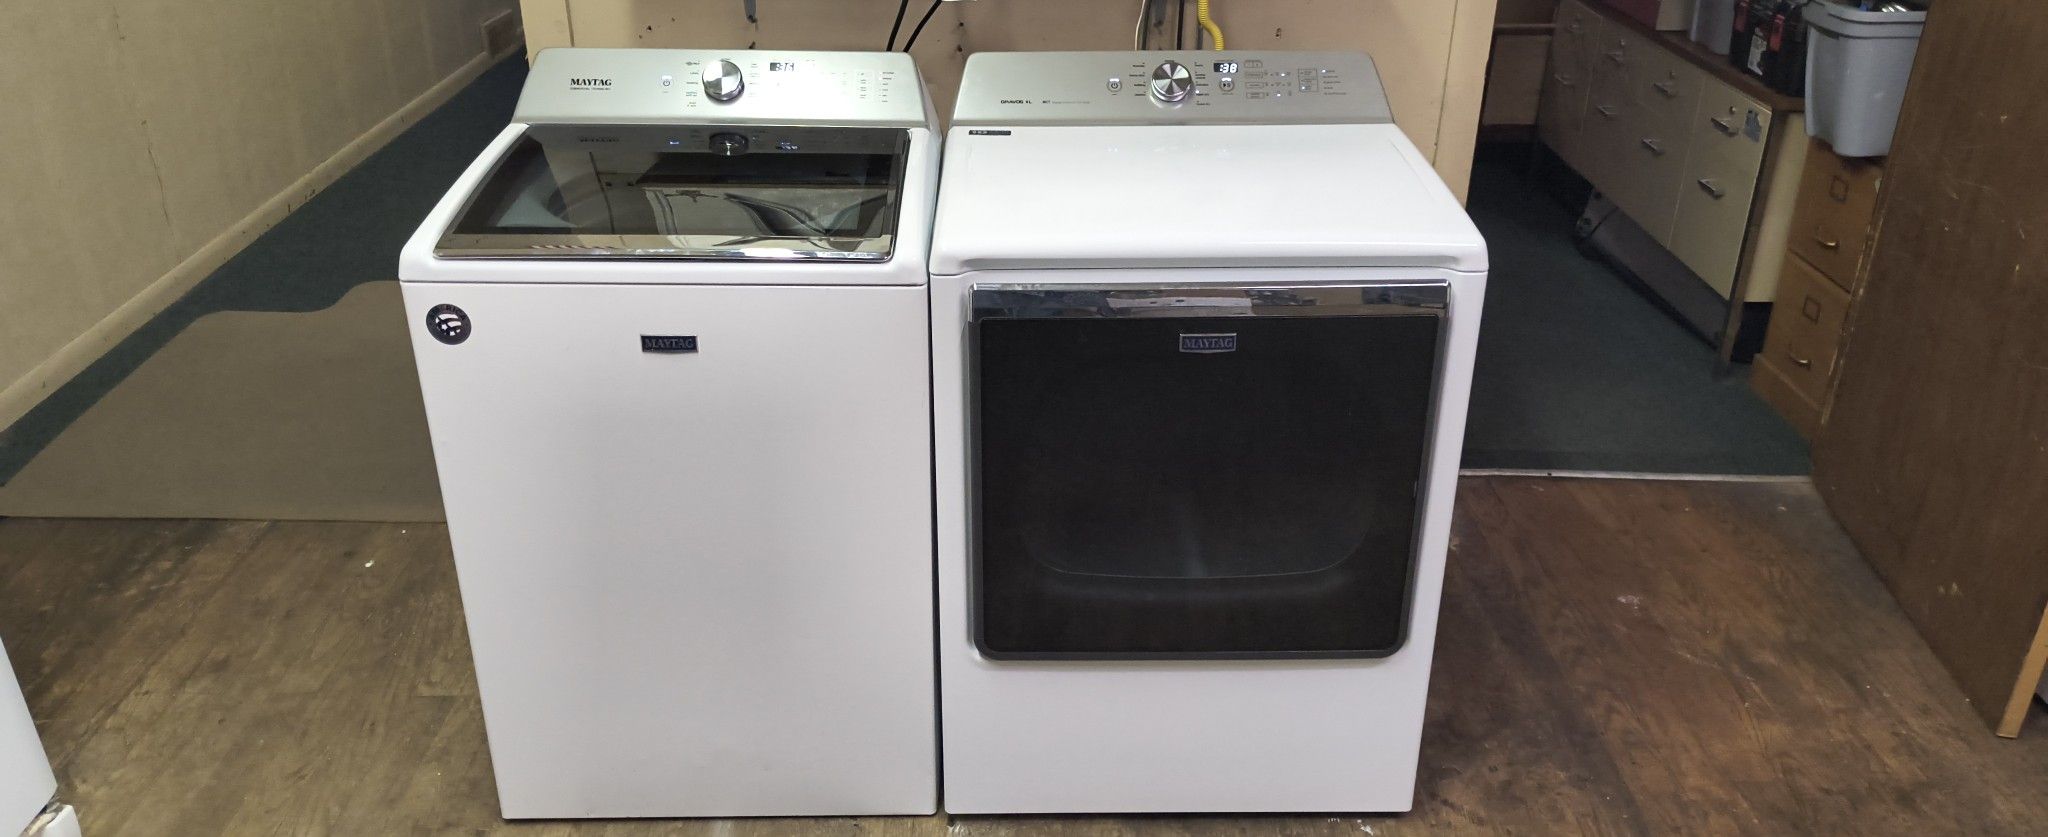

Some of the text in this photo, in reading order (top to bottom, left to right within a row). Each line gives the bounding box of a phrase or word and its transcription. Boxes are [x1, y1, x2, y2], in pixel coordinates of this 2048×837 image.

[570, 78, 612, 86] MAYTAG
[644, 338, 694, 348] MAYTAG
[1183, 338, 1234, 349] MAYTAG
